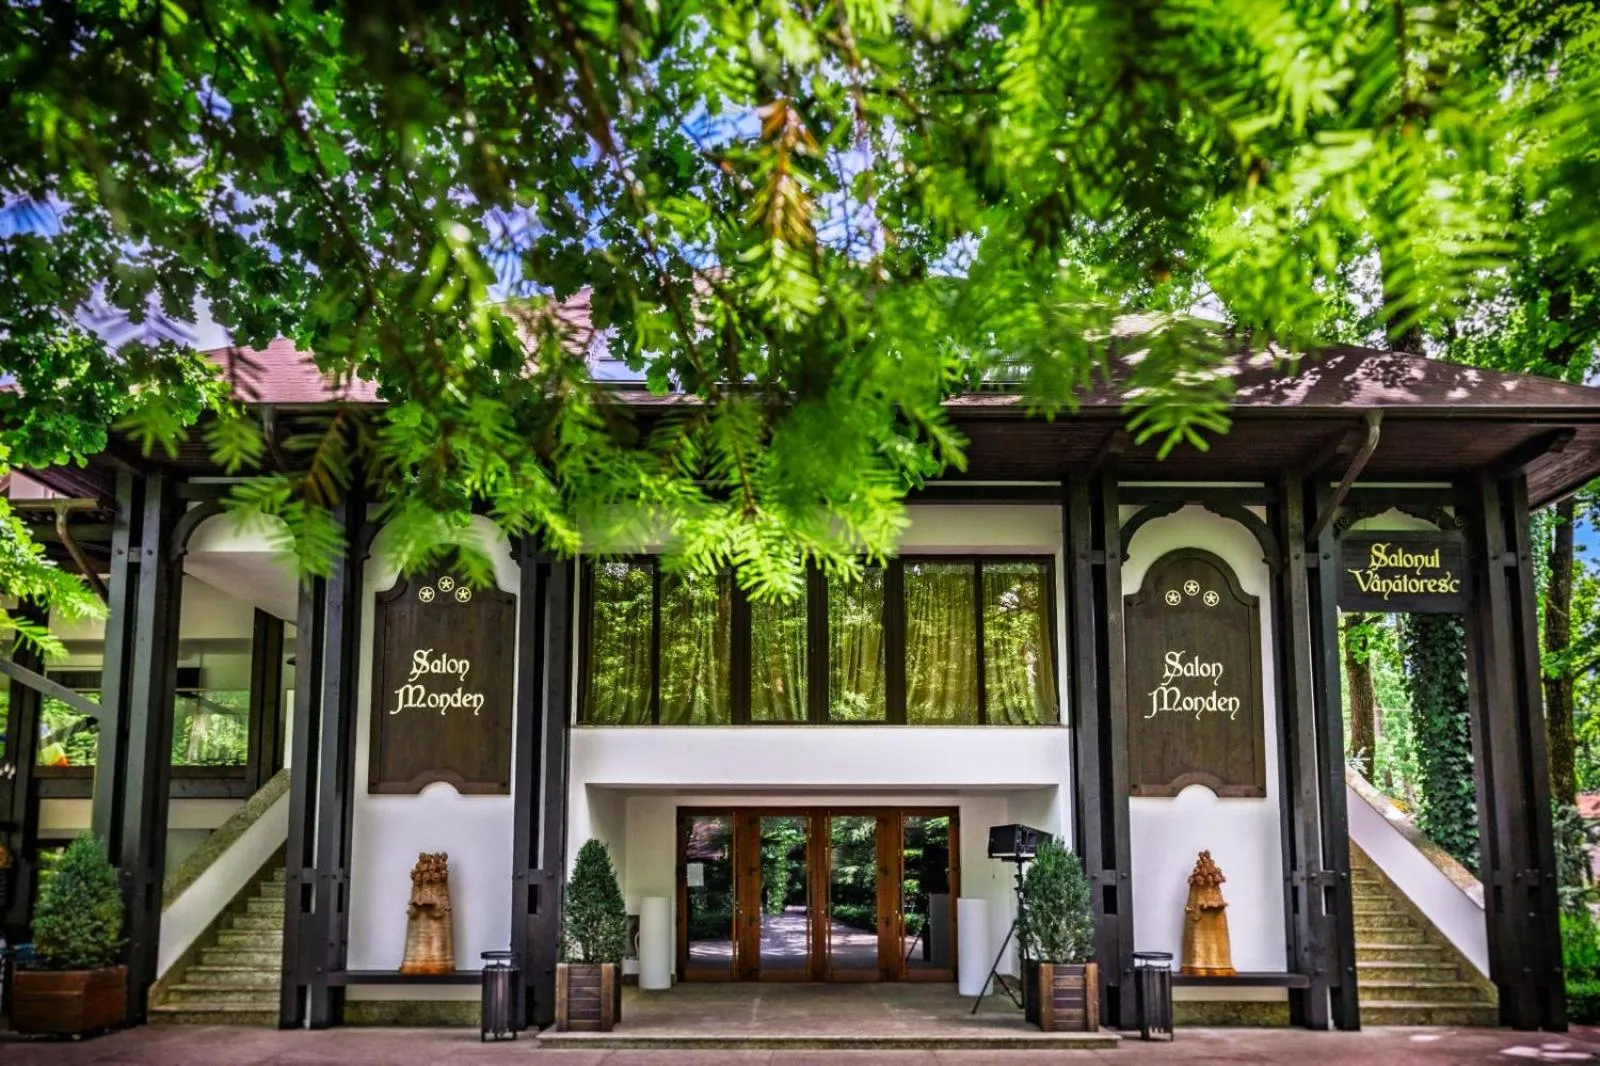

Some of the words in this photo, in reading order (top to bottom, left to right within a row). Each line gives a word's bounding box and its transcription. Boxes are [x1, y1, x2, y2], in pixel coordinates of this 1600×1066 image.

[1368, 542, 1440, 575] Salonul
[408, 649, 470, 682] Salon
[1161, 651, 1223, 685] Salon
[389, 684, 485, 715] Monden
[1144, 687, 1240, 720] Monden
